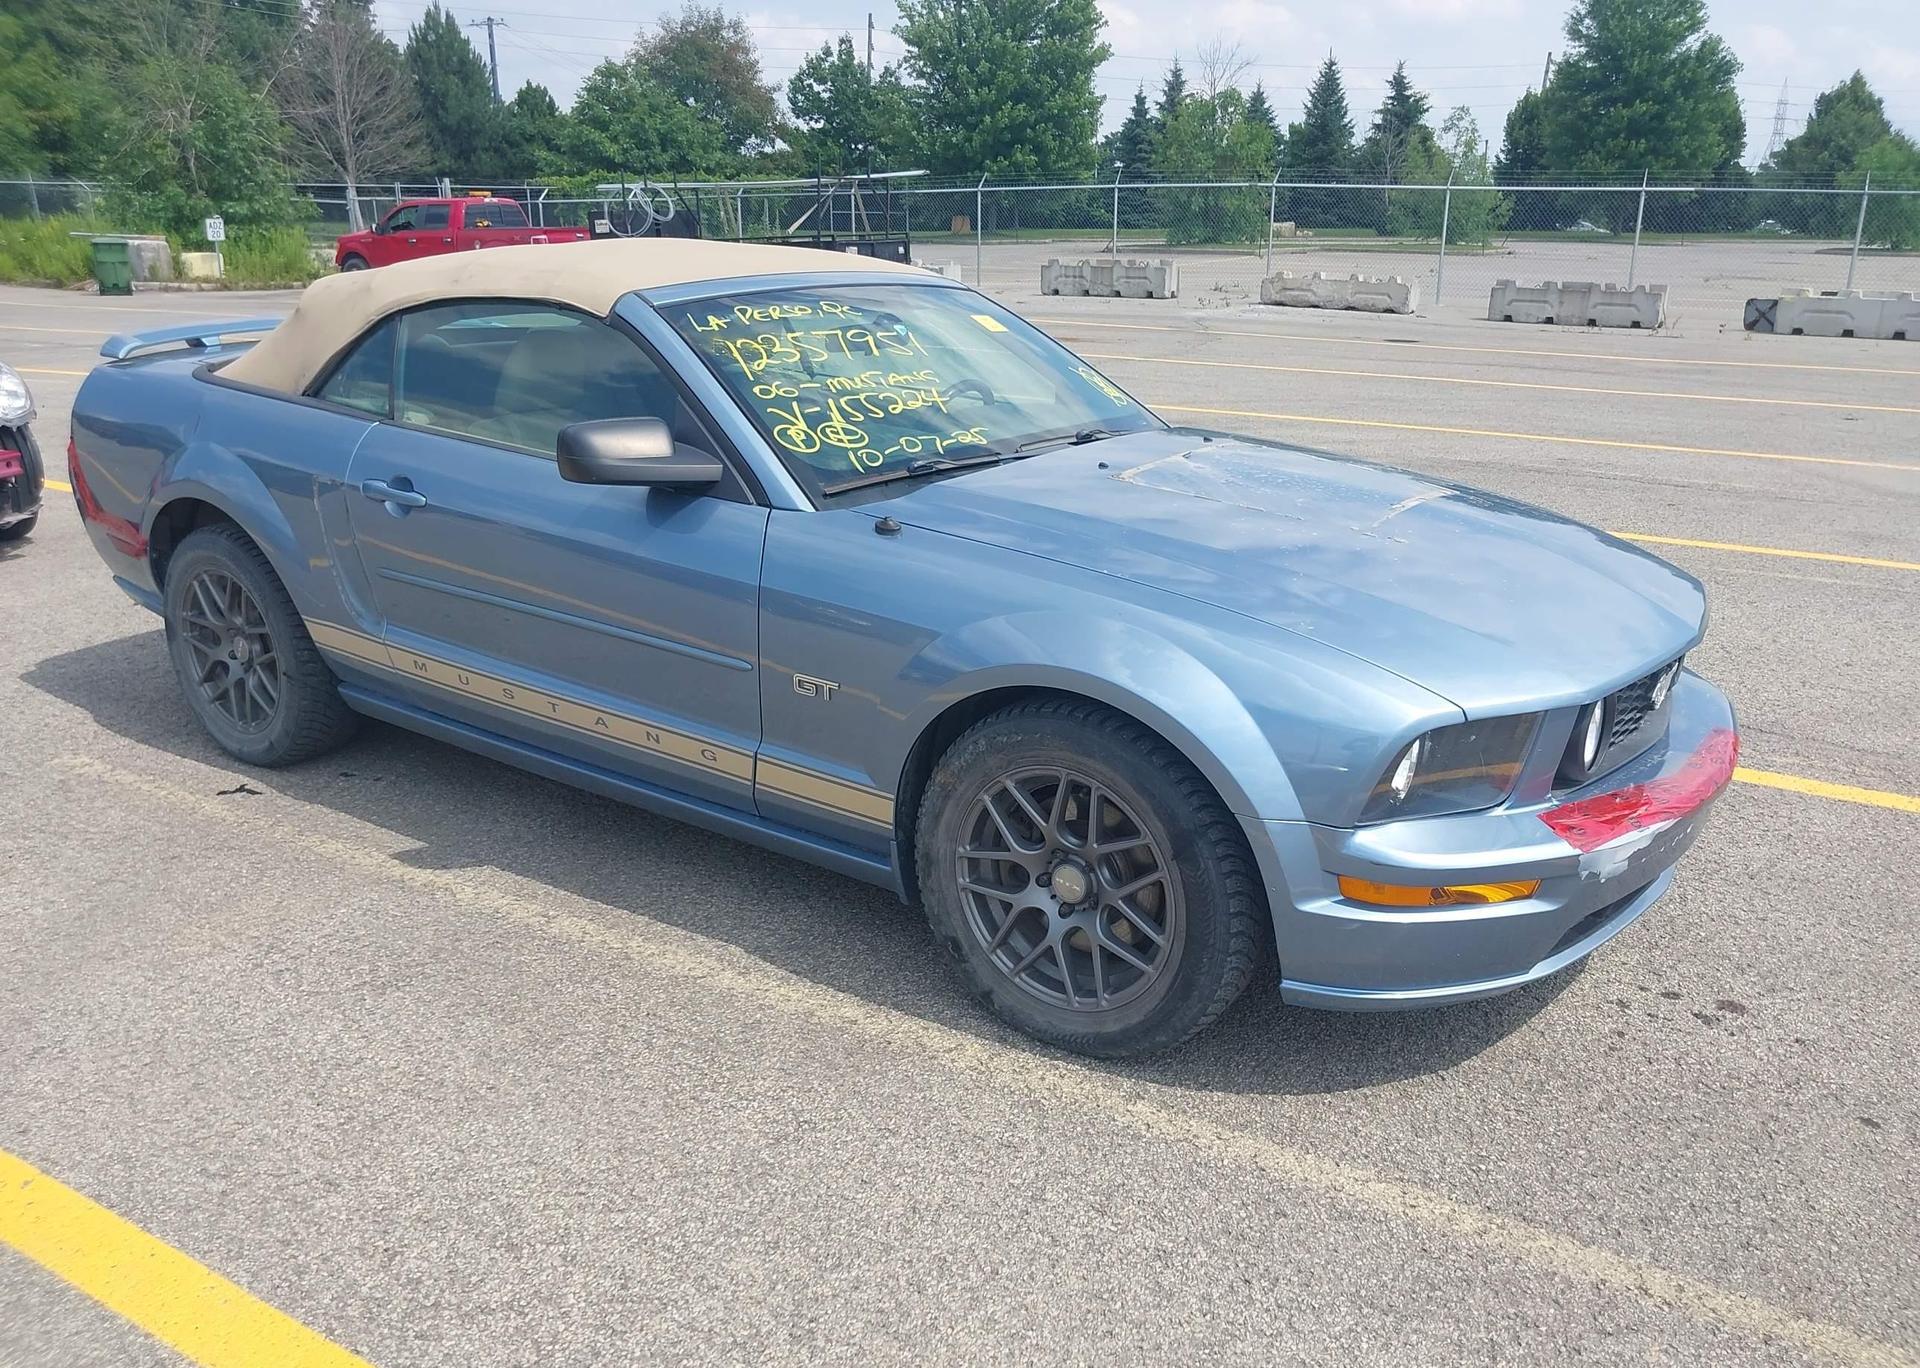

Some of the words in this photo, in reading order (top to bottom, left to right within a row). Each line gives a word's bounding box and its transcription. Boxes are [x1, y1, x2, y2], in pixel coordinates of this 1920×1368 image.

[211, 230, 221, 239] 20
[686, 312, 732, 333] LA
[712, 329, 929, 381] 12357951
[847, 427, 989, 475] 10-07-25
[793, 672, 840, 701] GT
[412, 659, 719, 764] MUSTANG
